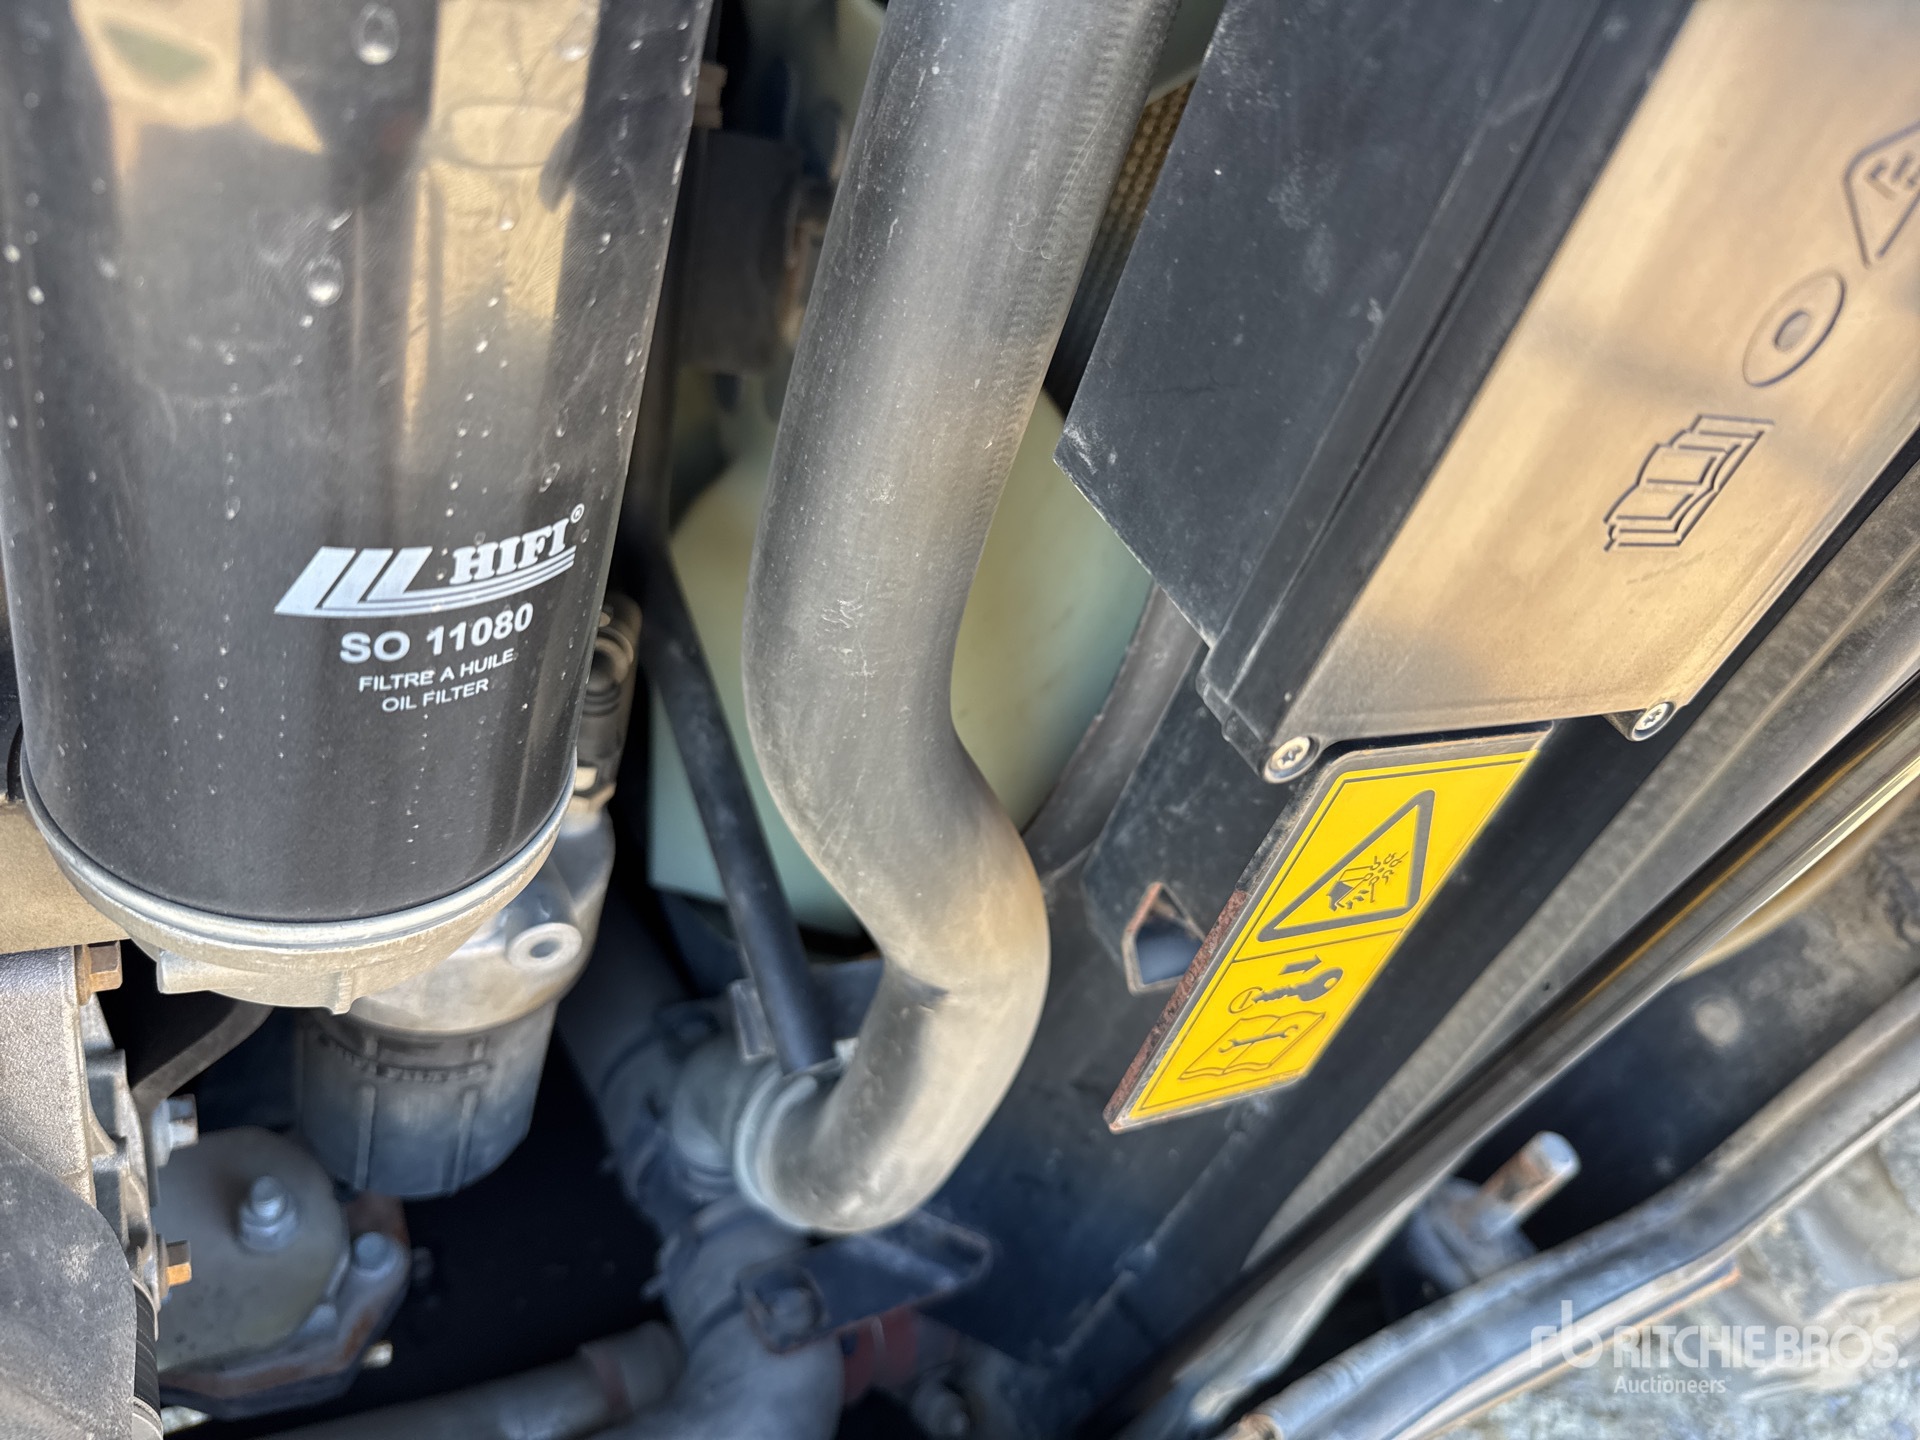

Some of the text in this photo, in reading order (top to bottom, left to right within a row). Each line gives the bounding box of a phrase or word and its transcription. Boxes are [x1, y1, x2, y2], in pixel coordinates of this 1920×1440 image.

[450, 519, 571, 585] HIFI
[340, 602, 534, 664] SO 11080
[358, 648, 516, 692] FILTRE A HUILE
[381, 678, 489, 712] OIL FILTER
